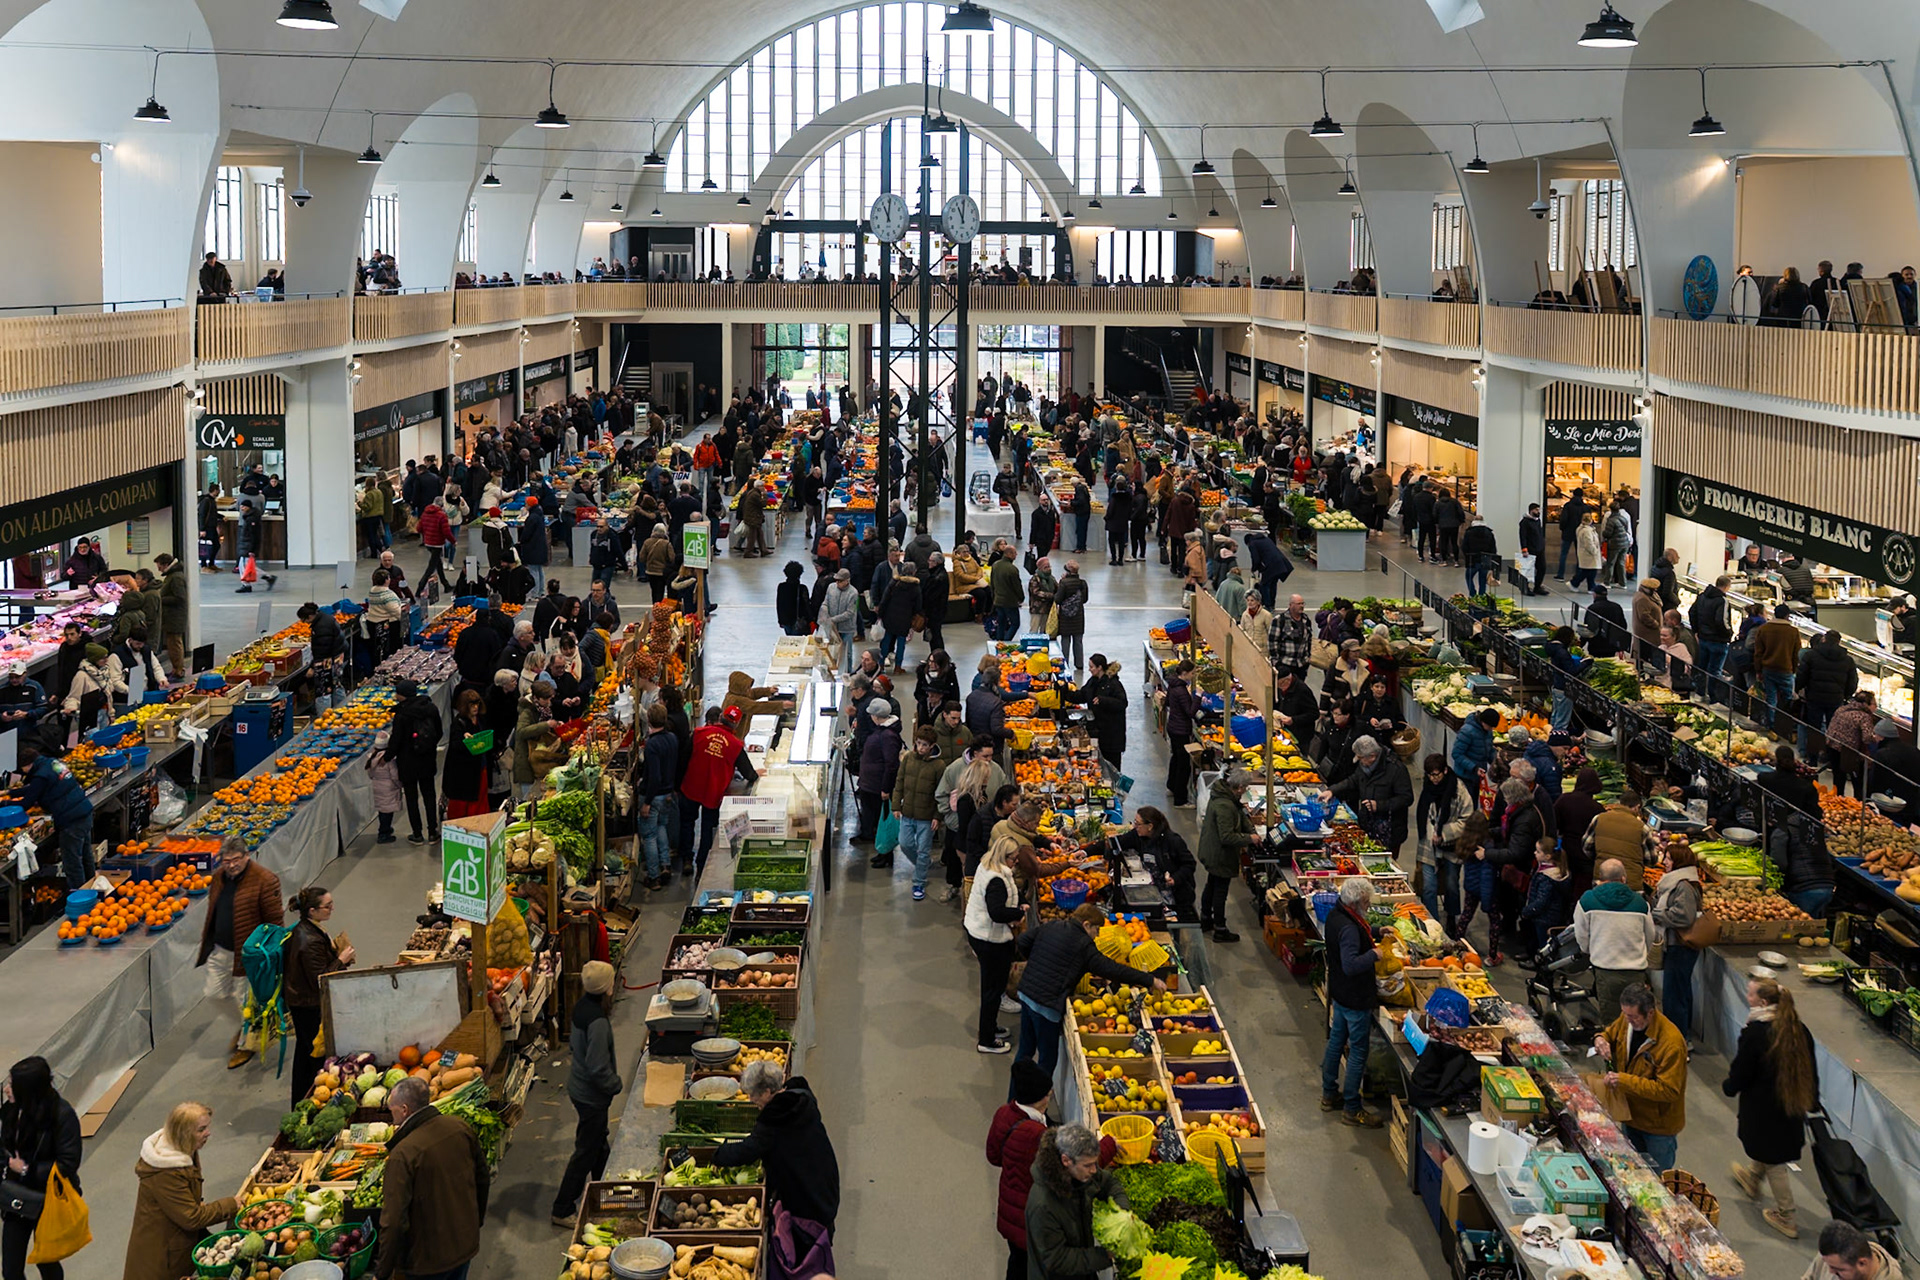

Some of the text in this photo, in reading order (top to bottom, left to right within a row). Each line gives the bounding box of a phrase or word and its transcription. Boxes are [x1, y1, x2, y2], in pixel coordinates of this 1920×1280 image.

[1563, 425, 1581, 443] La
[1583, 427, 1612, 442] Mie
[30, 479, 157, 536] ALDANA-COMPAN
[1703, 486, 1805, 534] FROMAGERIE
[1809, 515, 1872, 553] BLANC
[686, 539, 704, 556] AB
[446, 858, 480, 896] AB
